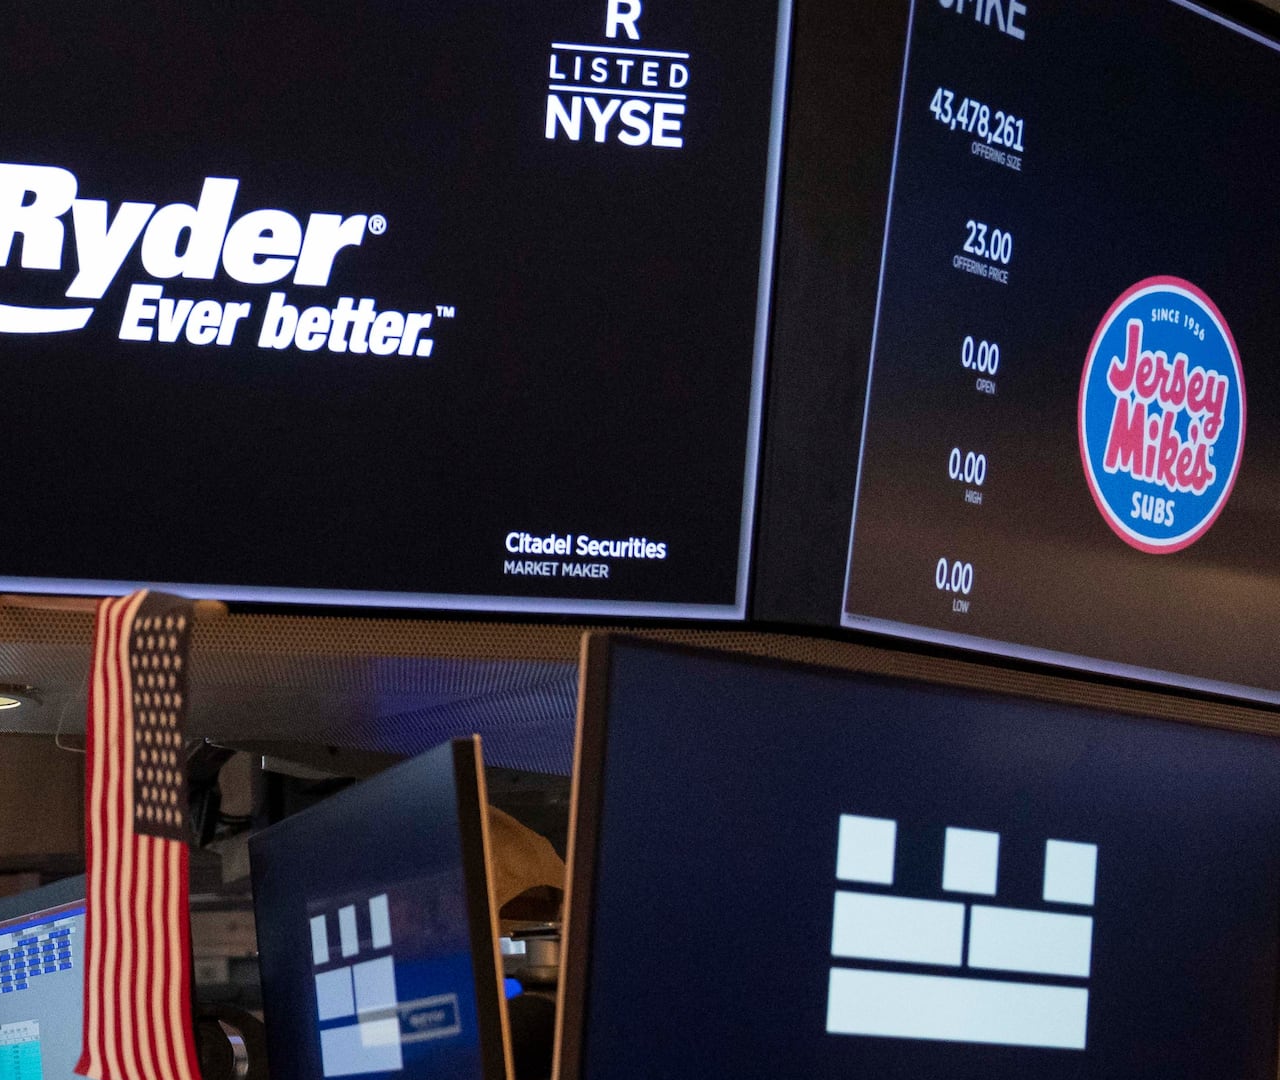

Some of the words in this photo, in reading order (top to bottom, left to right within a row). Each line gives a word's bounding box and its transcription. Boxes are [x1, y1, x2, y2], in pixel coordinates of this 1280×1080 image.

[549, 54, 689, 88] LISTED
[545, 94, 685, 148] NYSE
[930, 87, 1024, 152] 43,478,261
[971, 141, 1006, 166] OFFERING
[1006, 154, 1022, 172] SIZE
[963, 219, 1013, 265] 23.00
[953, 255, 989, 278] OFFERING
[989, 267, 1008, 285] PRICE
[118, 283, 249, 345] Ever
[1151, 308, 1180, 324] SINCE
[1183, 314, 1206, 342] 1956
[961, 335, 1000, 375] 0.00
[976, 378, 997, 395] OPEN
[1108, 321, 1228, 441] Jersey
[1104, 396, 1215, 493] Mike's
[948, 447, 987, 486] 0.00
[964, 489, 983, 505] HIGH
[1130, 491, 1175, 527] SUBS
[505, 532, 572, 555] Citadel
[575, 535, 667, 559] Securities
[503, 560, 559, 576] MARKET
[561, 563, 609, 578] MAKER
[935, 557, 973, 595] 0.00
[952, 598, 970, 614] LOW
